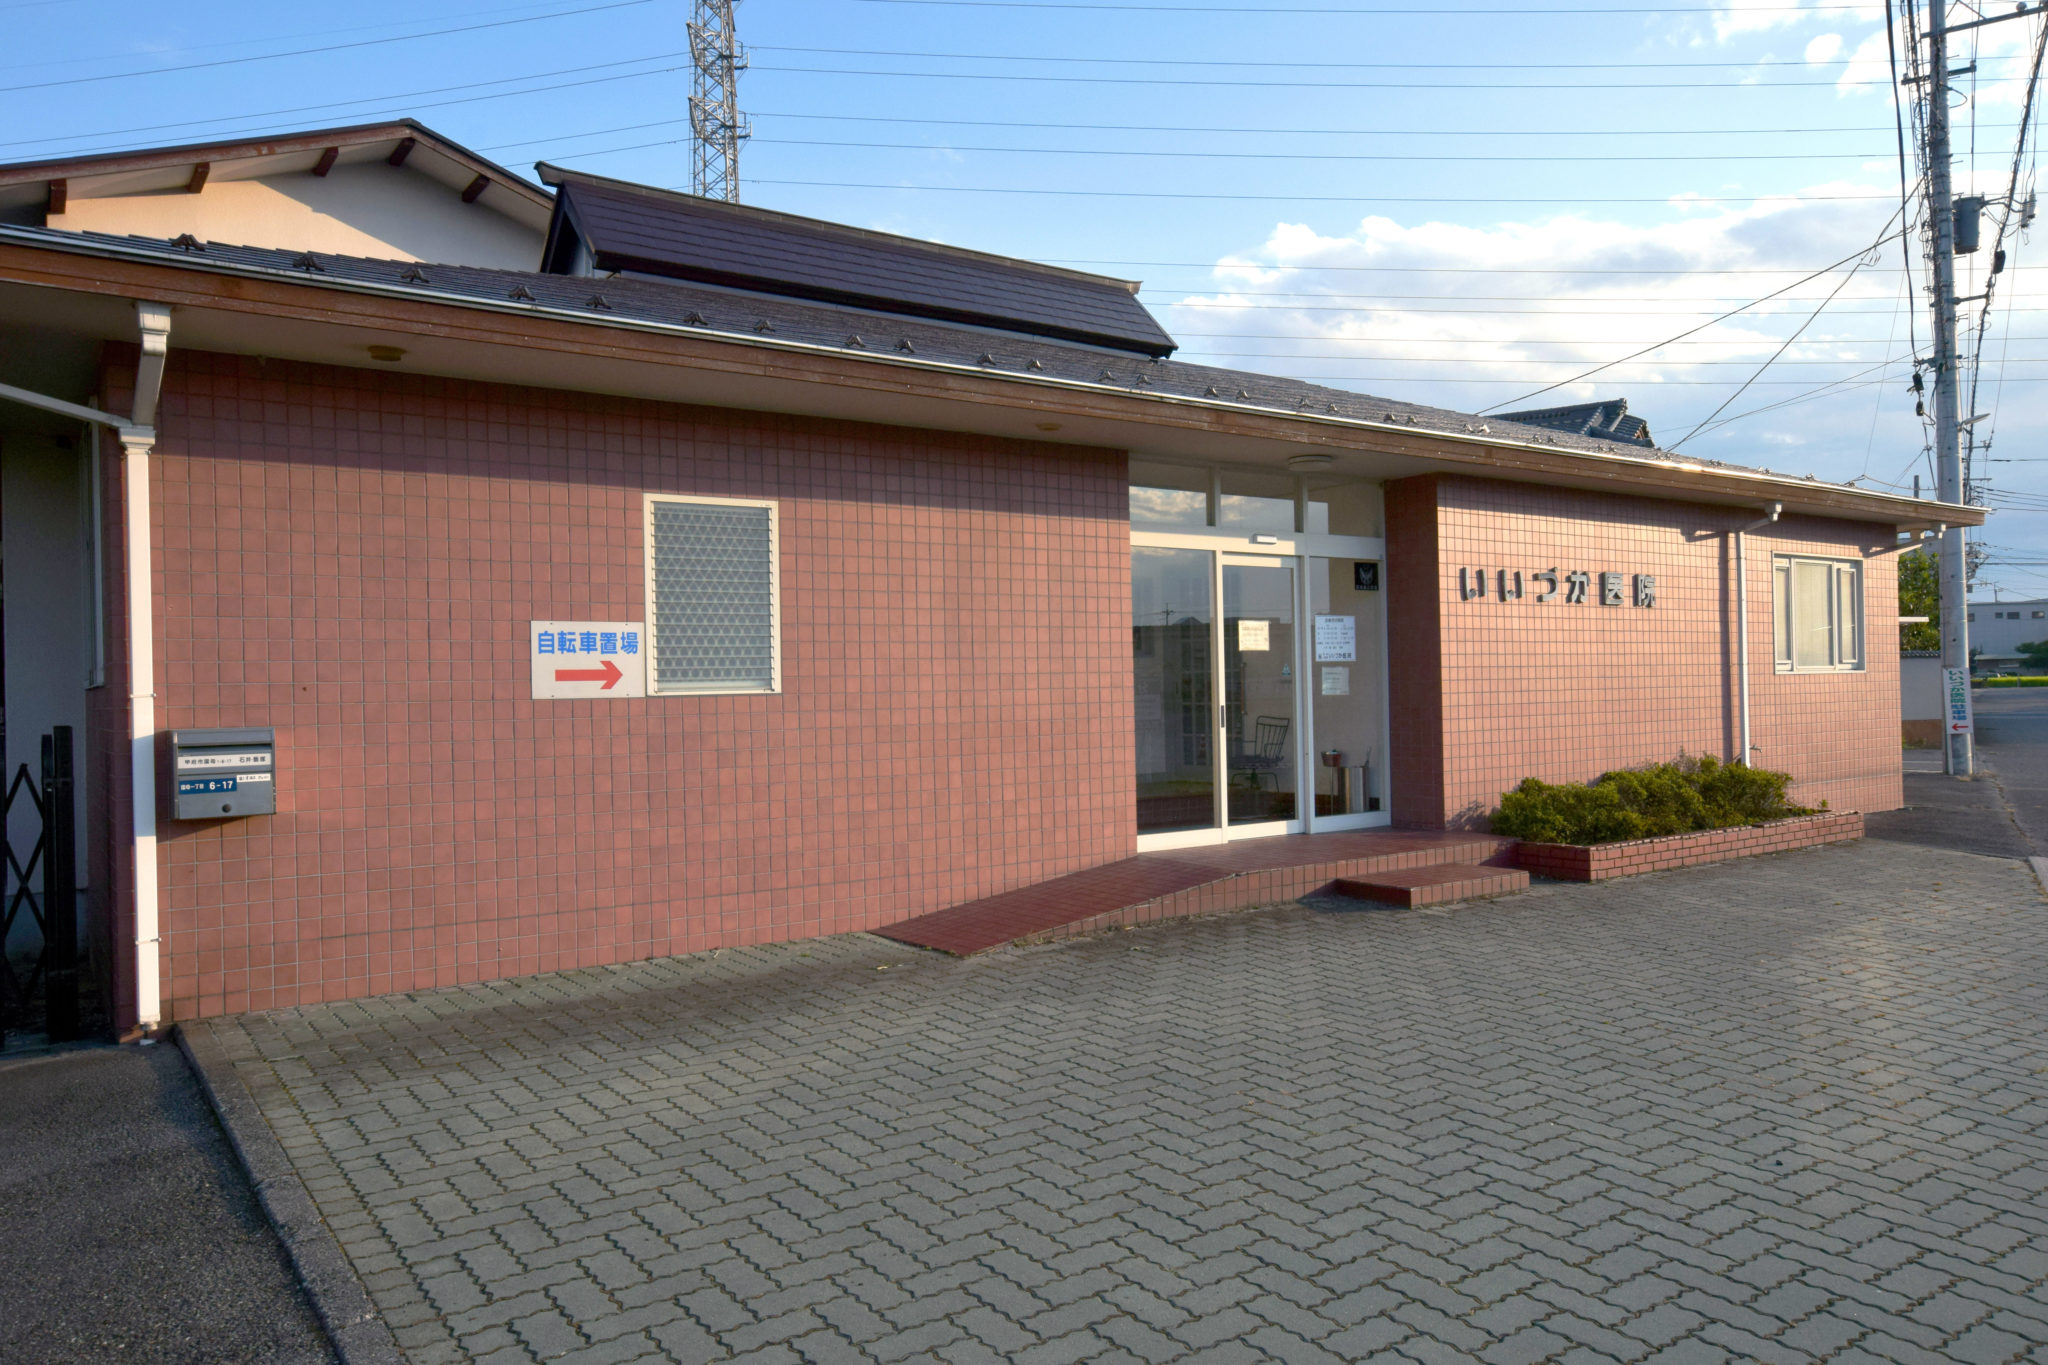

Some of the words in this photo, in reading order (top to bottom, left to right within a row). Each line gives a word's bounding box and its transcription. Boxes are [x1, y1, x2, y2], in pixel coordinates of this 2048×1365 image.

[1459, 567, 1656, 607] いいづか医院
[538, 631, 639, 654] 自転車置場
[210, 780, 233, 791] 6-17
